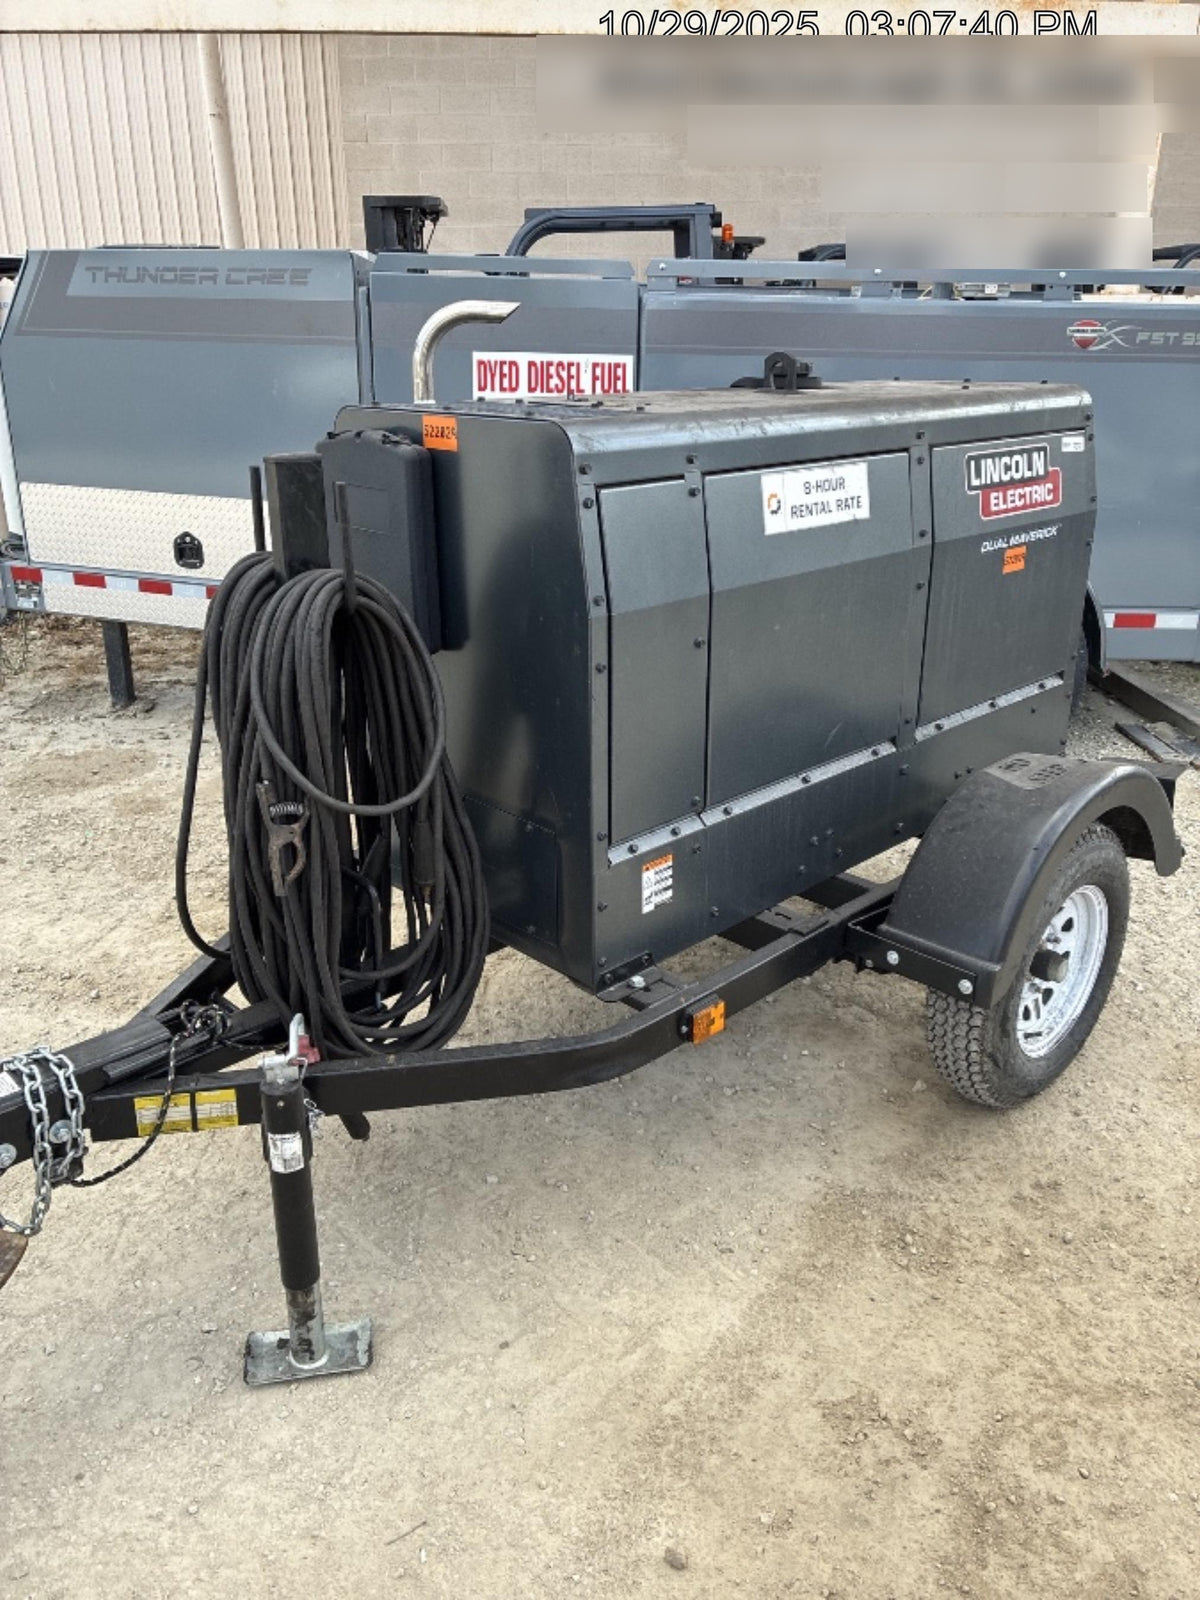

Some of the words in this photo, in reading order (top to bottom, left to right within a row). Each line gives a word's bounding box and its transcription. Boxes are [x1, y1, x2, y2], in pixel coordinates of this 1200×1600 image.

[85, 265, 219, 285] THUNDER
[1136, 331, 1180, 345] FST
[476, 359, 520, 393] DYED
[527, 360, 585, 394] DIESEL
[591, 361, 630, 395] FUEL
[970, 450, 1045, 487] LINCOLN
[803, 476, 846, 495] 8-HOUR
[790, 500, 833, 520] RENTAL
[835, 495, 863, 513] RATE
[989, 482, 1054, 512] ELECTRIC
[981, 537, 1009, 554] DUAL
